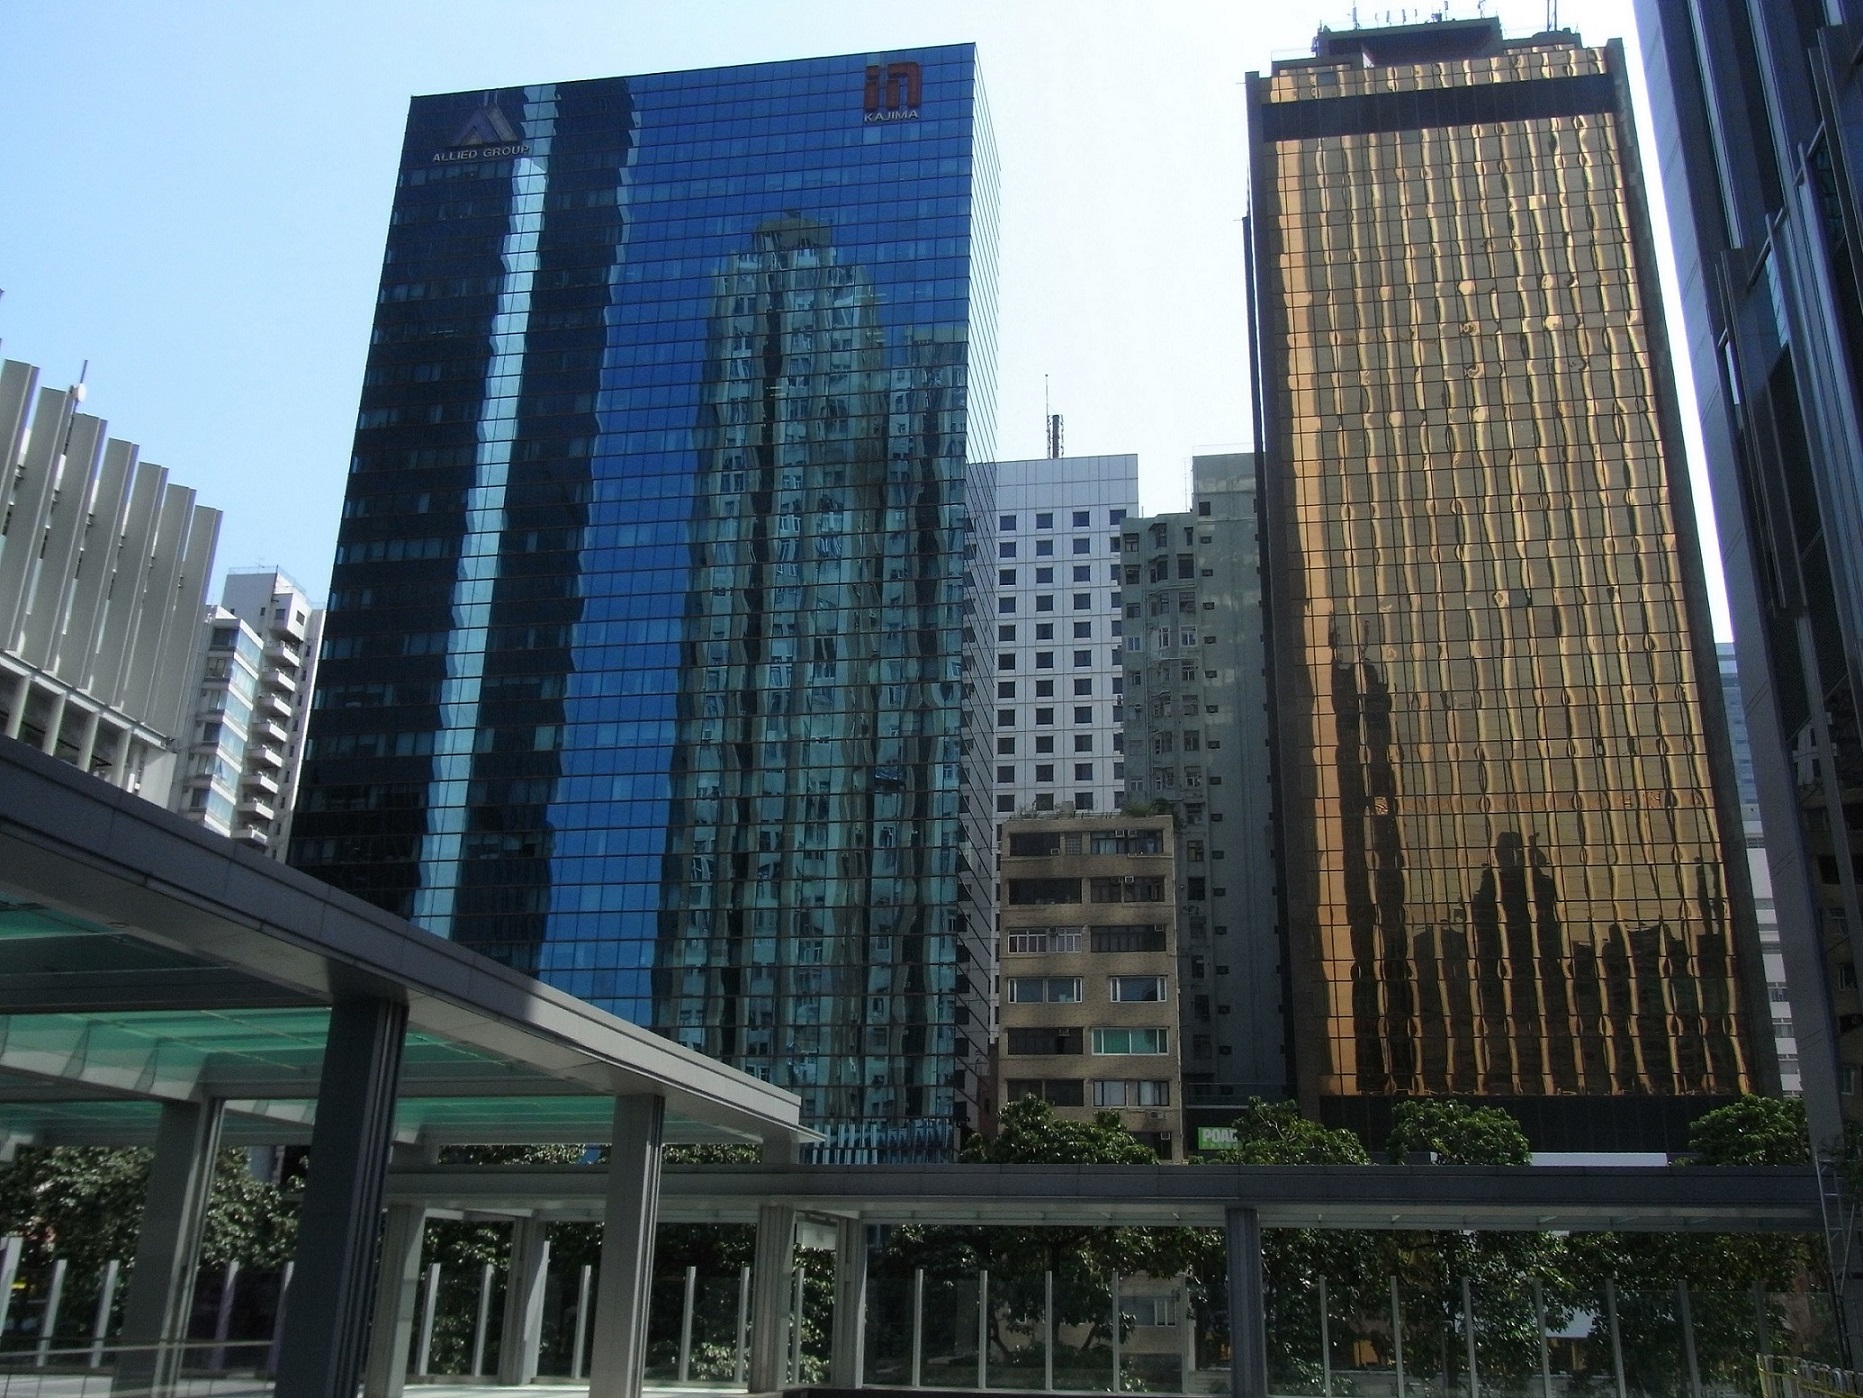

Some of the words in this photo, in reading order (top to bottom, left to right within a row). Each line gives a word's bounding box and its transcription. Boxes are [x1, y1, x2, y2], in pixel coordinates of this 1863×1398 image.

[864, 111, 919, 122] KAJIMA
[432, 149, 478, 163] ALLIED
[482, 145, 530, 158] GROUP
